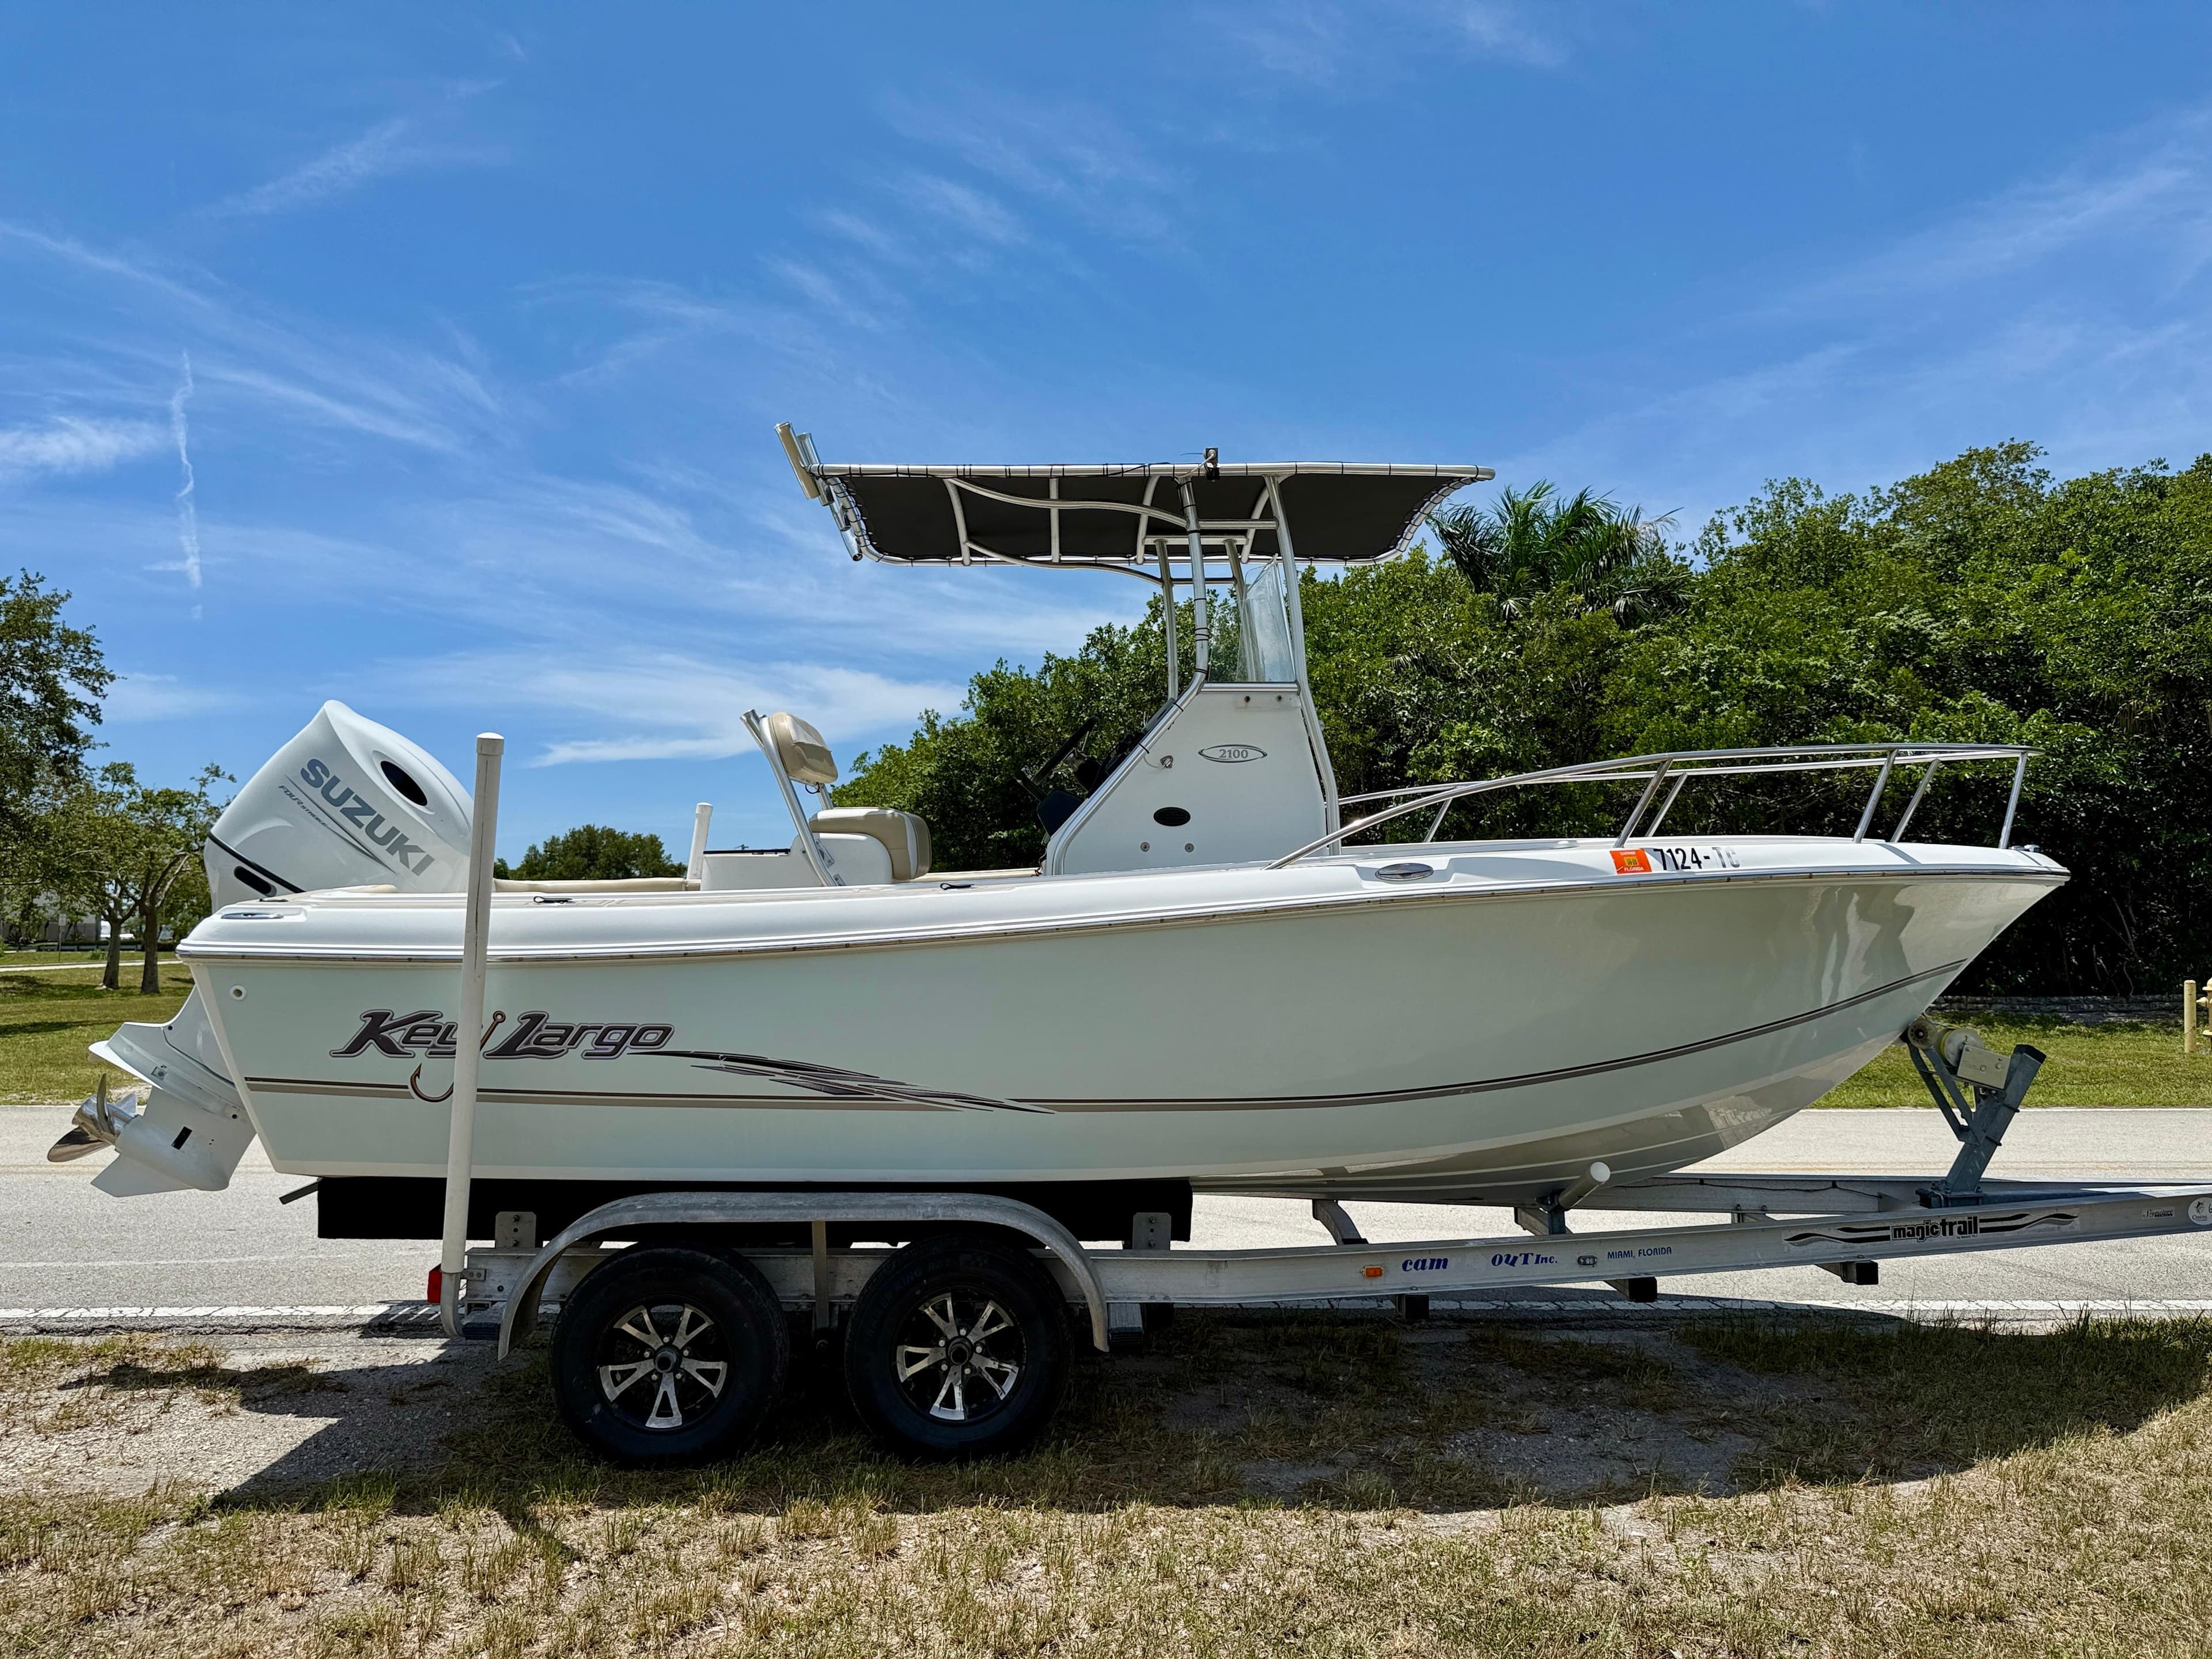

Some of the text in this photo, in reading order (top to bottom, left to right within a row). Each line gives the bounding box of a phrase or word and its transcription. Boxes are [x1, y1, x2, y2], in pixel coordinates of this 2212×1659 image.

[1219, 749, 1249, 759] 2100
[300, 758, 435, 876] SUZUKI
[329, 1009, 675, 1060] Key Largo
[1891, 1216, 1978, 1243] magictrail
[1402, 1257, 1448, 1271] cam
[1534, 1254, 1558, 1264] Inc.
[1607, 1247, 1672, 1259] MIAMI, FLORIDA
